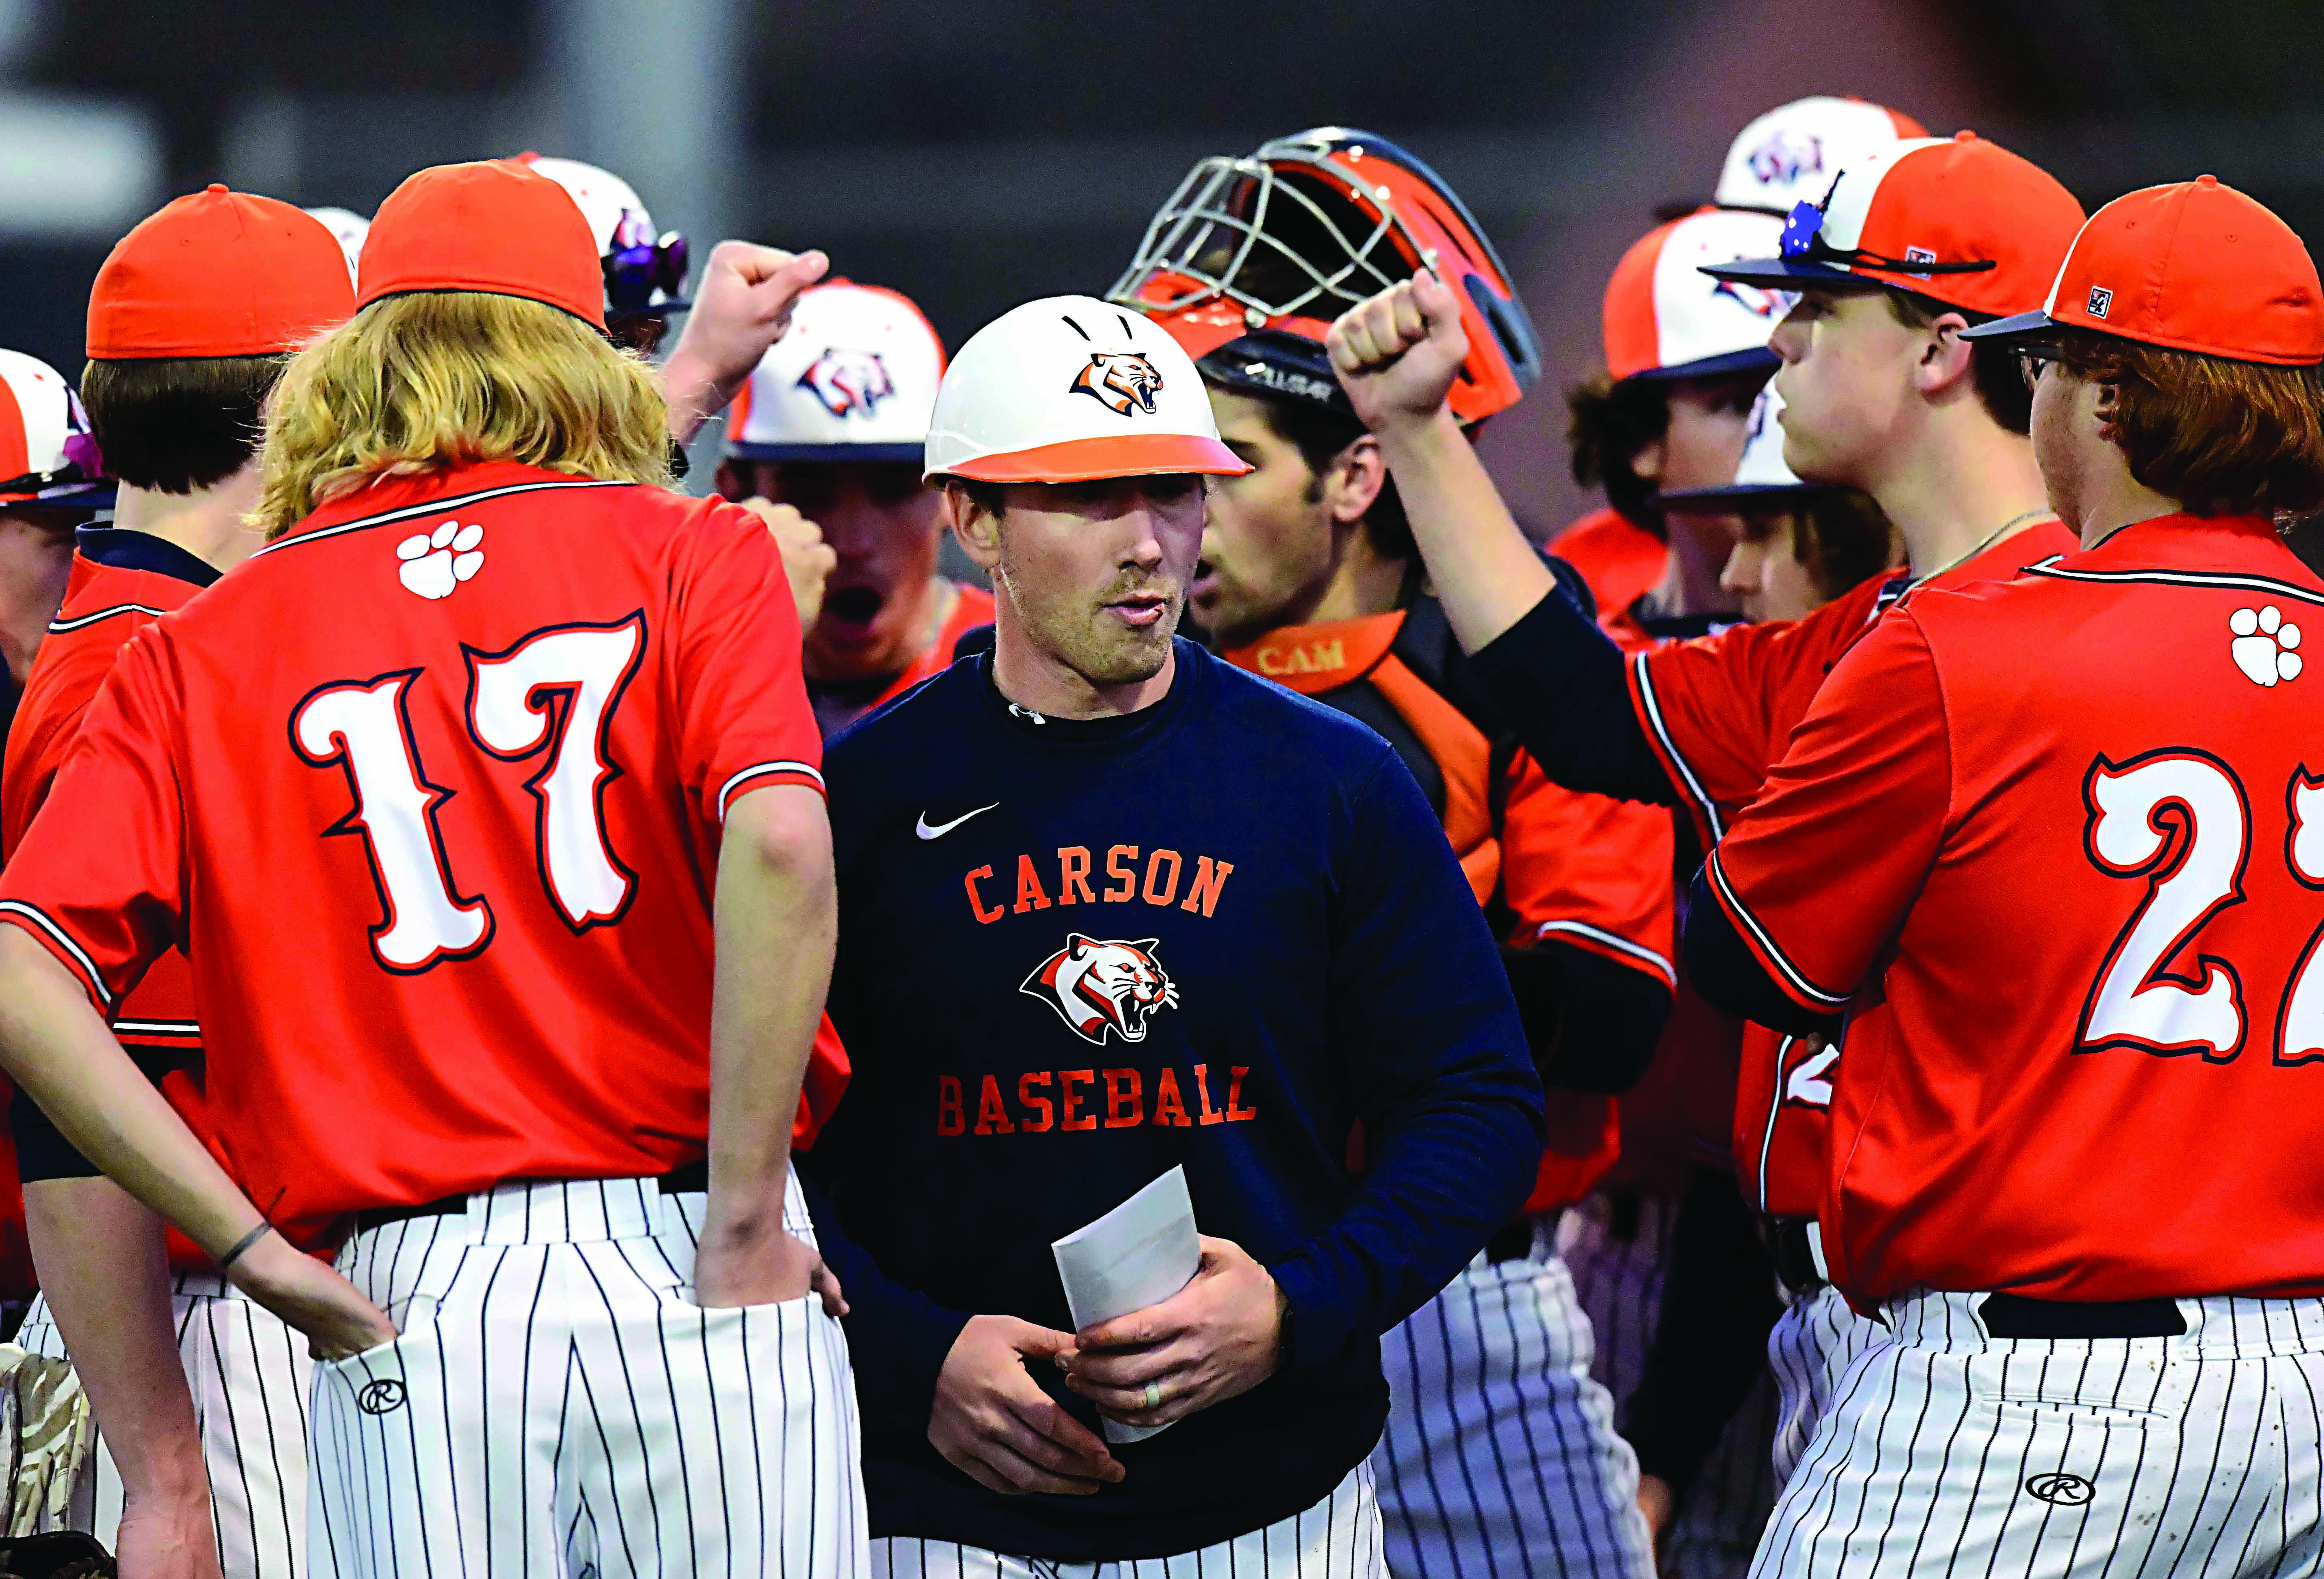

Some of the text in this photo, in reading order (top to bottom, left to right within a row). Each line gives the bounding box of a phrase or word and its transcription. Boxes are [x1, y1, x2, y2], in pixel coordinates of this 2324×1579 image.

[1258, 639, 1345, 675] CAM
[287, 608, 648, 976] 17
[964, 844, 1234, 924] CARSON
[2071, 746, 2324, 1067] 2
[937, 1064, 1257, 1137] BASEBALL
